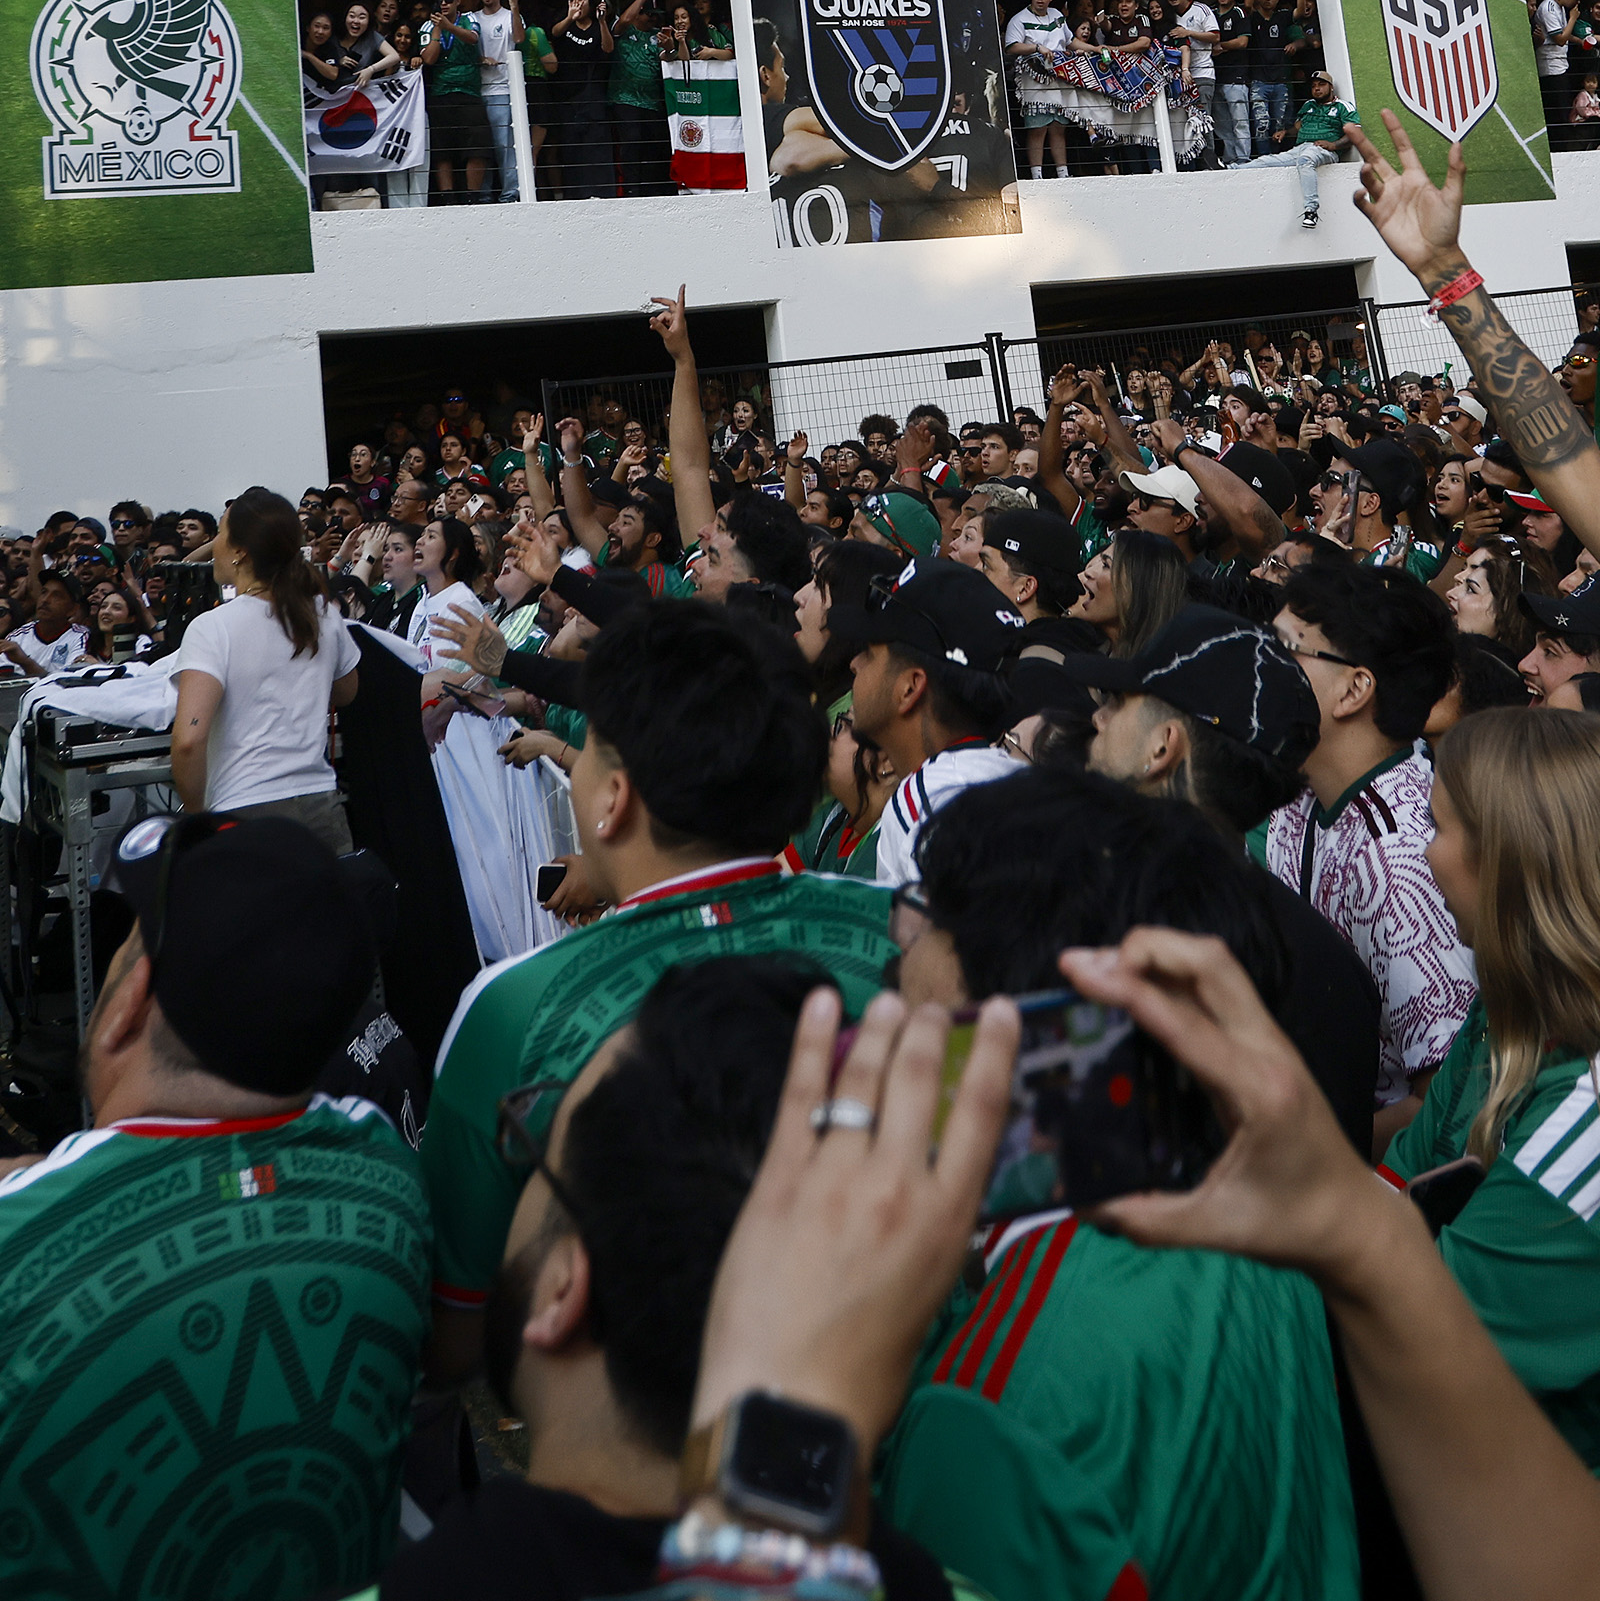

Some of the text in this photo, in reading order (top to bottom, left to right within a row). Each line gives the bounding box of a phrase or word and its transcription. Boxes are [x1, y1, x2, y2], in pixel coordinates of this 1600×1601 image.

[841, 19, 860, 27] SAN
[862, 19, 885, 27] JOSE
[58, 141, 225, 184] MÉXICO
